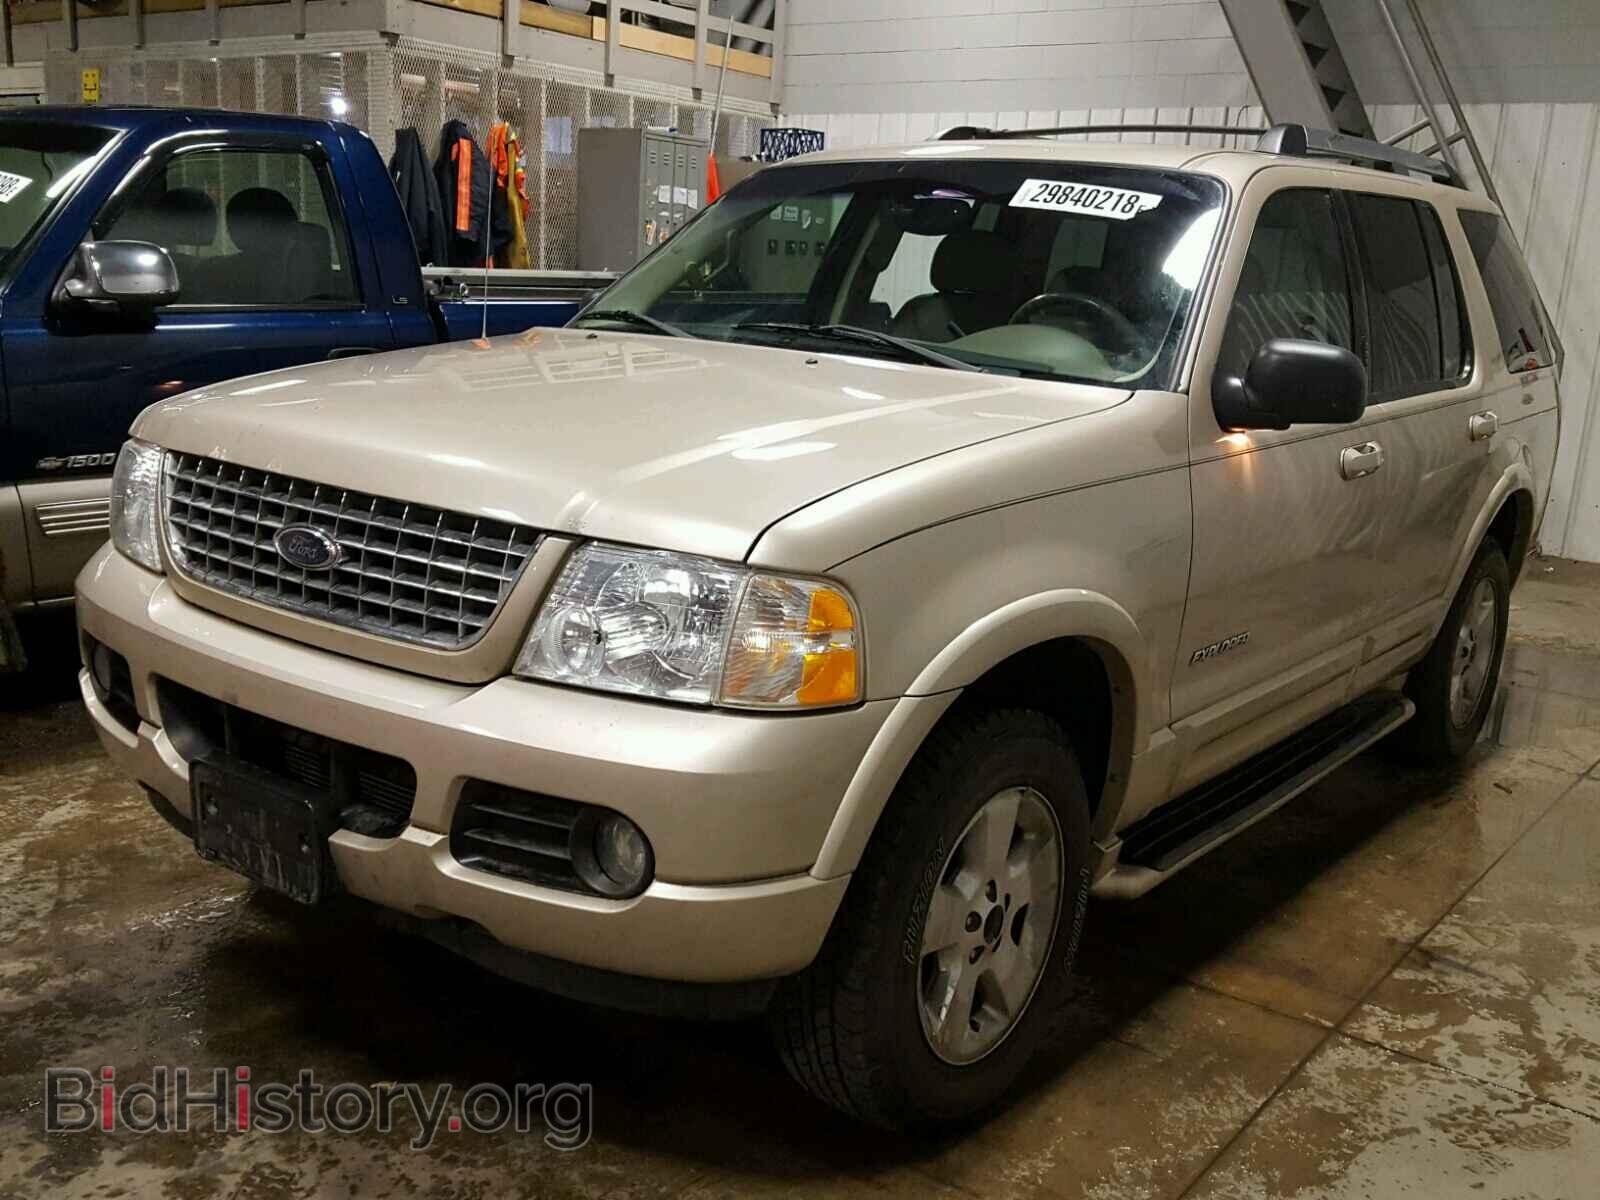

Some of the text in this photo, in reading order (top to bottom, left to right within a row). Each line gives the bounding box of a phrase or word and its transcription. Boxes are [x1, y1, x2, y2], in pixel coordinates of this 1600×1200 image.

[1030, 183, 1140, 214] 29840218
[66, 453, 117, 468] 1500
[288, 534, 318, 560] Ford
